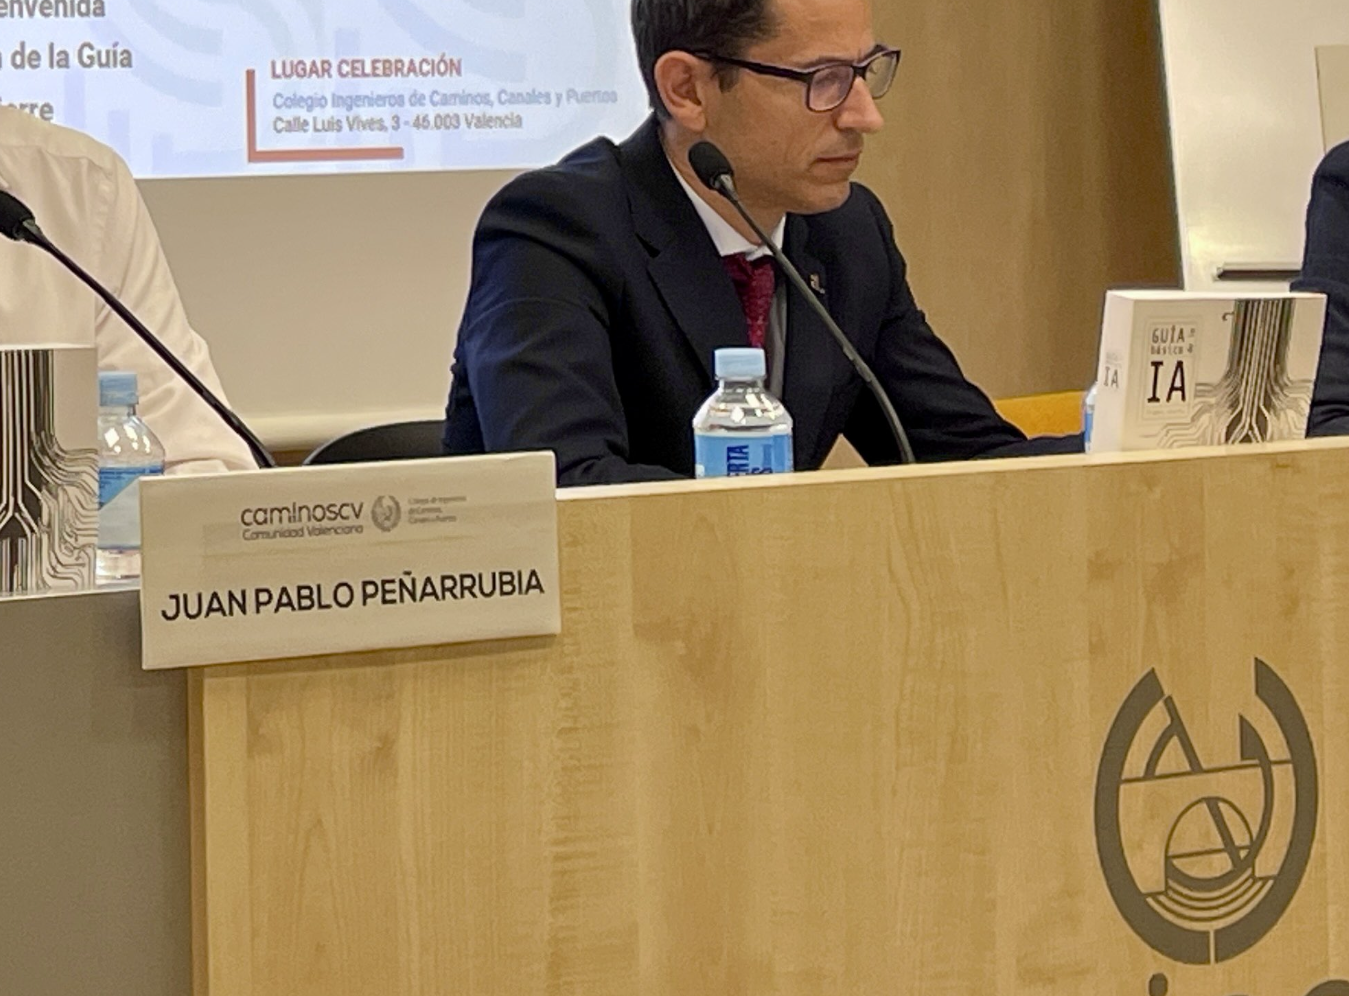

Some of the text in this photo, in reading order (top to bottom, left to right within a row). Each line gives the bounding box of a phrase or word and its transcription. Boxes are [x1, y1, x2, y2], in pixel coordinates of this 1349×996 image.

[10, 40, 42, 70] de
[48, 41, 70, 70] la
[77, 40, 134, 70] Guía
[271, 52, 462, 79] LUGAR CELEBRACIÓN
[273, 112, 523, 134] Calle Luis Vives, 3 46.003 Valencia
[1103, 365, 1120, 389] IA
[1147, 360, 1187, 404] IA
[241, 501, 364, 527] caminoscv
[161, 569, 544, 621] JUAN PABLO PEÑARRUBIA
